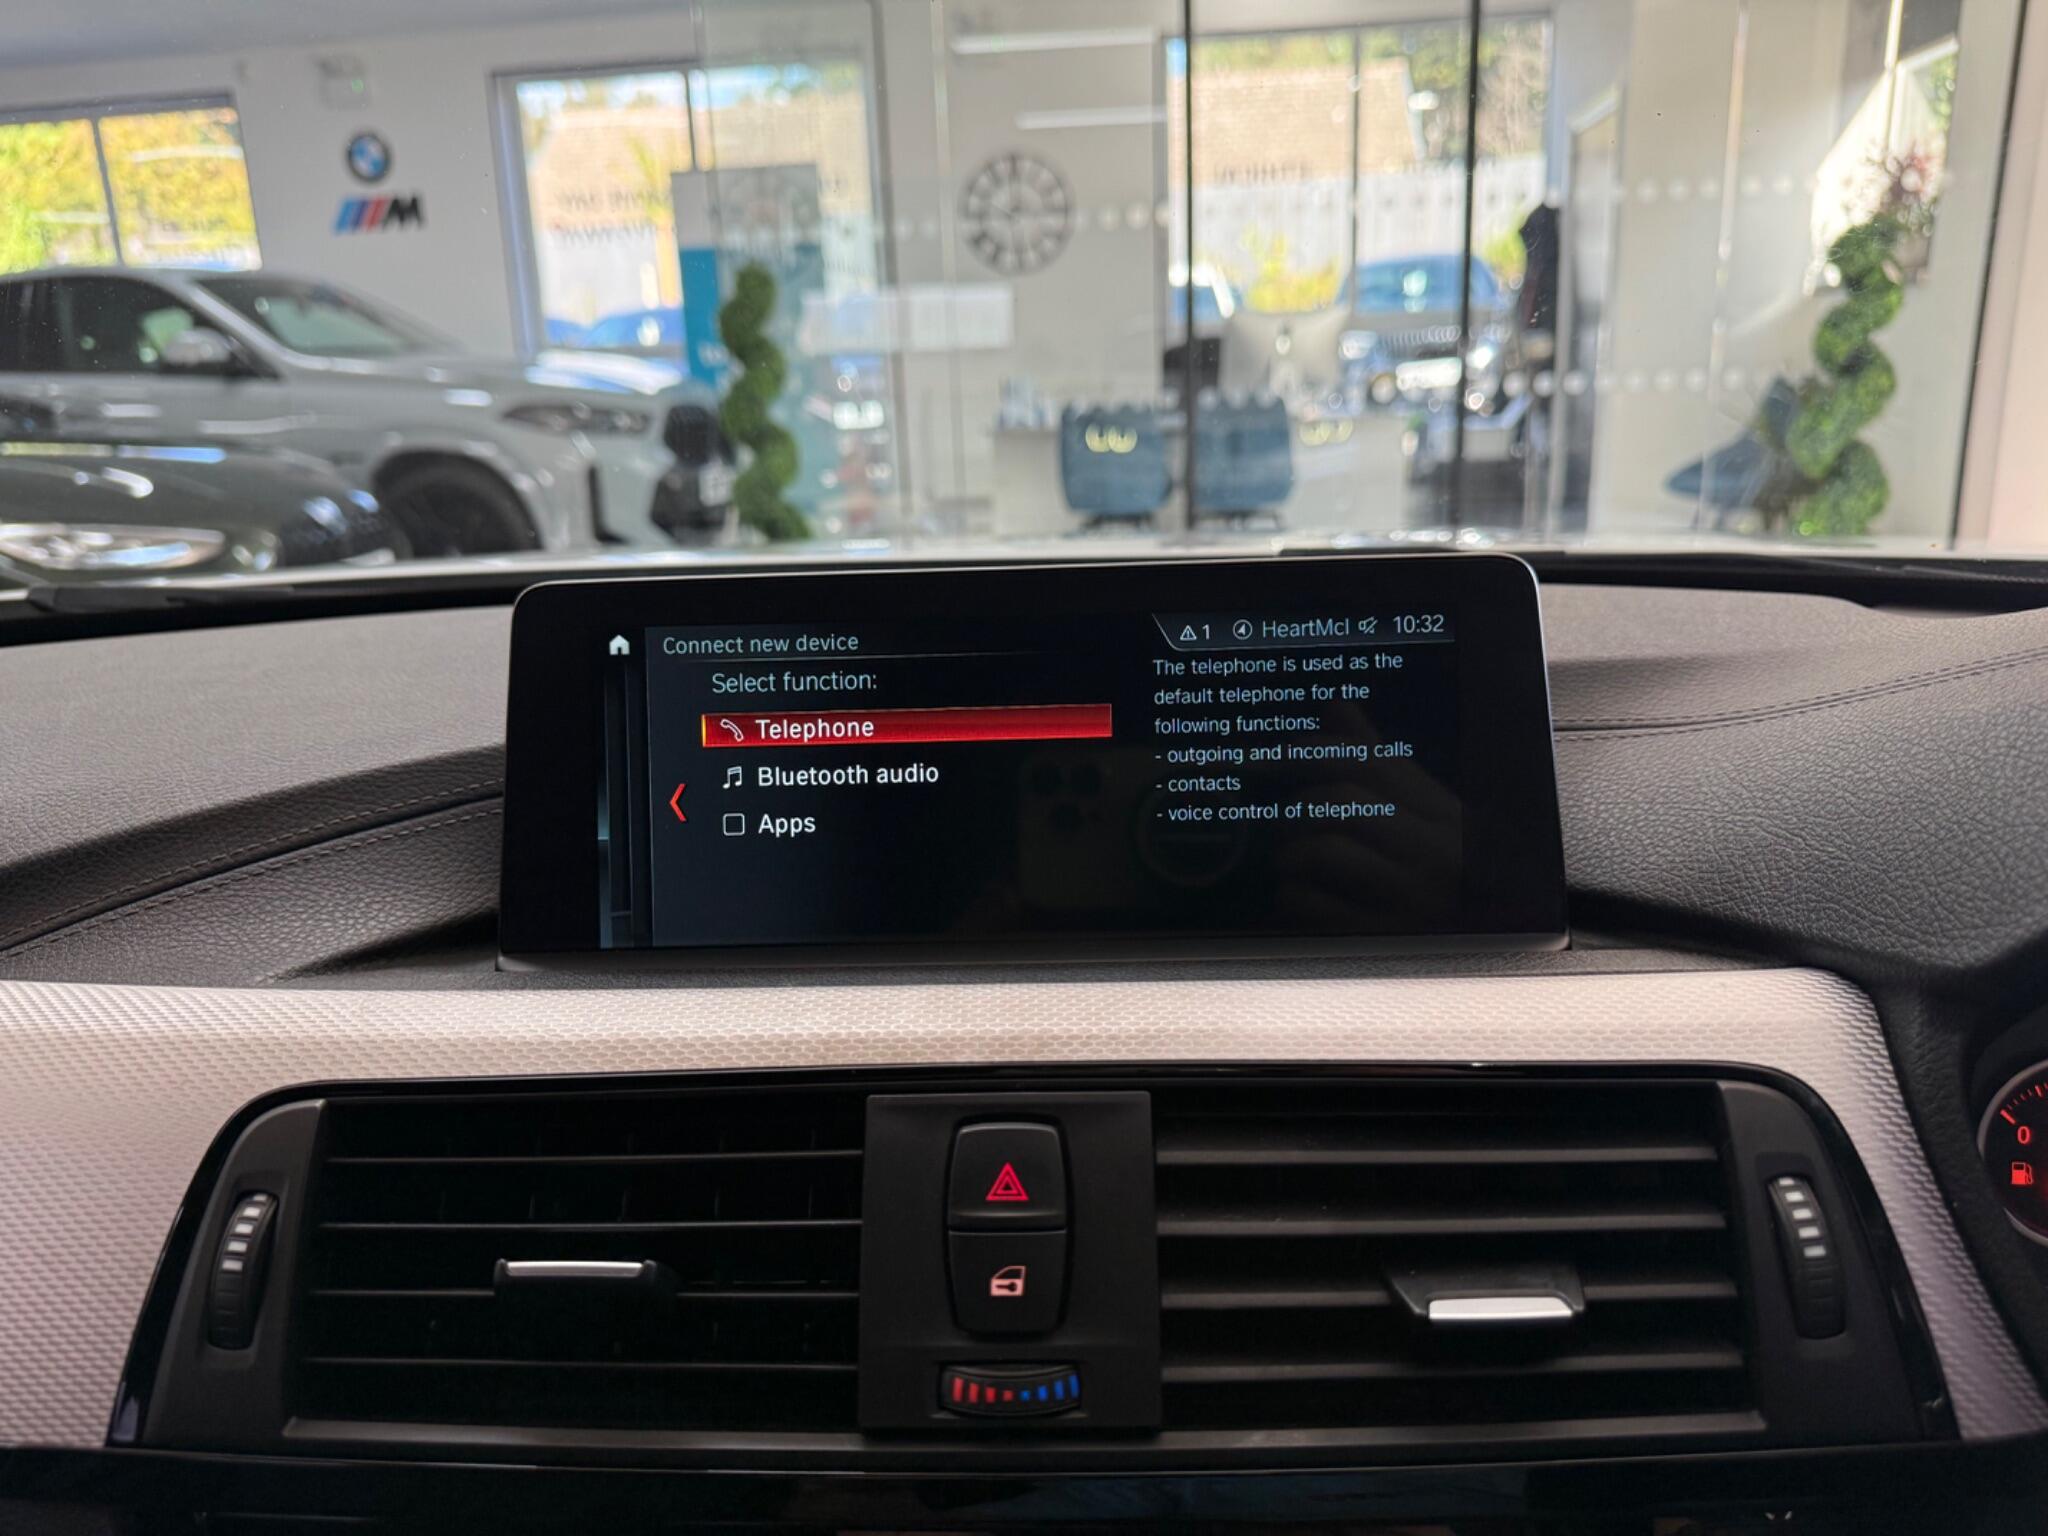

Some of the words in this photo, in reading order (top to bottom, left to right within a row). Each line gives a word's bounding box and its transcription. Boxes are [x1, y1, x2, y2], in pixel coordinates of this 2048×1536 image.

[1202, 624, 1210, 640] 1
[1393, 614, 1444, 634] 10:32
[663, 636, 744, 655] Connect
[749, 638, 790, 653] new
[795, 633, 859, 652] device
[1152, 659, 1186, 676] The
[1191, 657, 1277, 677] telephone
[1282, 655, 1297, 672] is
[1302, 654, 1343, 672] used
[1349, 656, 1369, 670] as
[1374, 652, 1403, 669] the
[712, 672, 776, 694] Select
[782, 670, 877, 692] function:
[1153, 687, 1213, 705] default
[1219, 686, 1306, 705] telephone
[1311, 683, 1336, 701] for
[1340, 683, 1370, 700] the
[754, 718, 875, 743] Telephone
[1154, 717, 1230, 736] following
[1236, 714, 1320, 732] functions:
[1167, 745, 1244, 766] outgoing
[1249, 744, 1282, 761] and
[1288, 742, 1368, 762] incoming
[1373, 741, 1414, 758] calls
[758, 764, 869, 787] Bluetooth
[876, 762, 939, 784] audio
[1168, 775, 1242, 793] contacts
[1168, 804, 1213, 821] voice
[1218, 802, 1279, 820] control
[1284, 801, 1303, 819] of
[1307, 801, 1396, 821] telephone
[758, 813, 816, 838] Apps
[2016, 1125, 2032, 1145] 0
